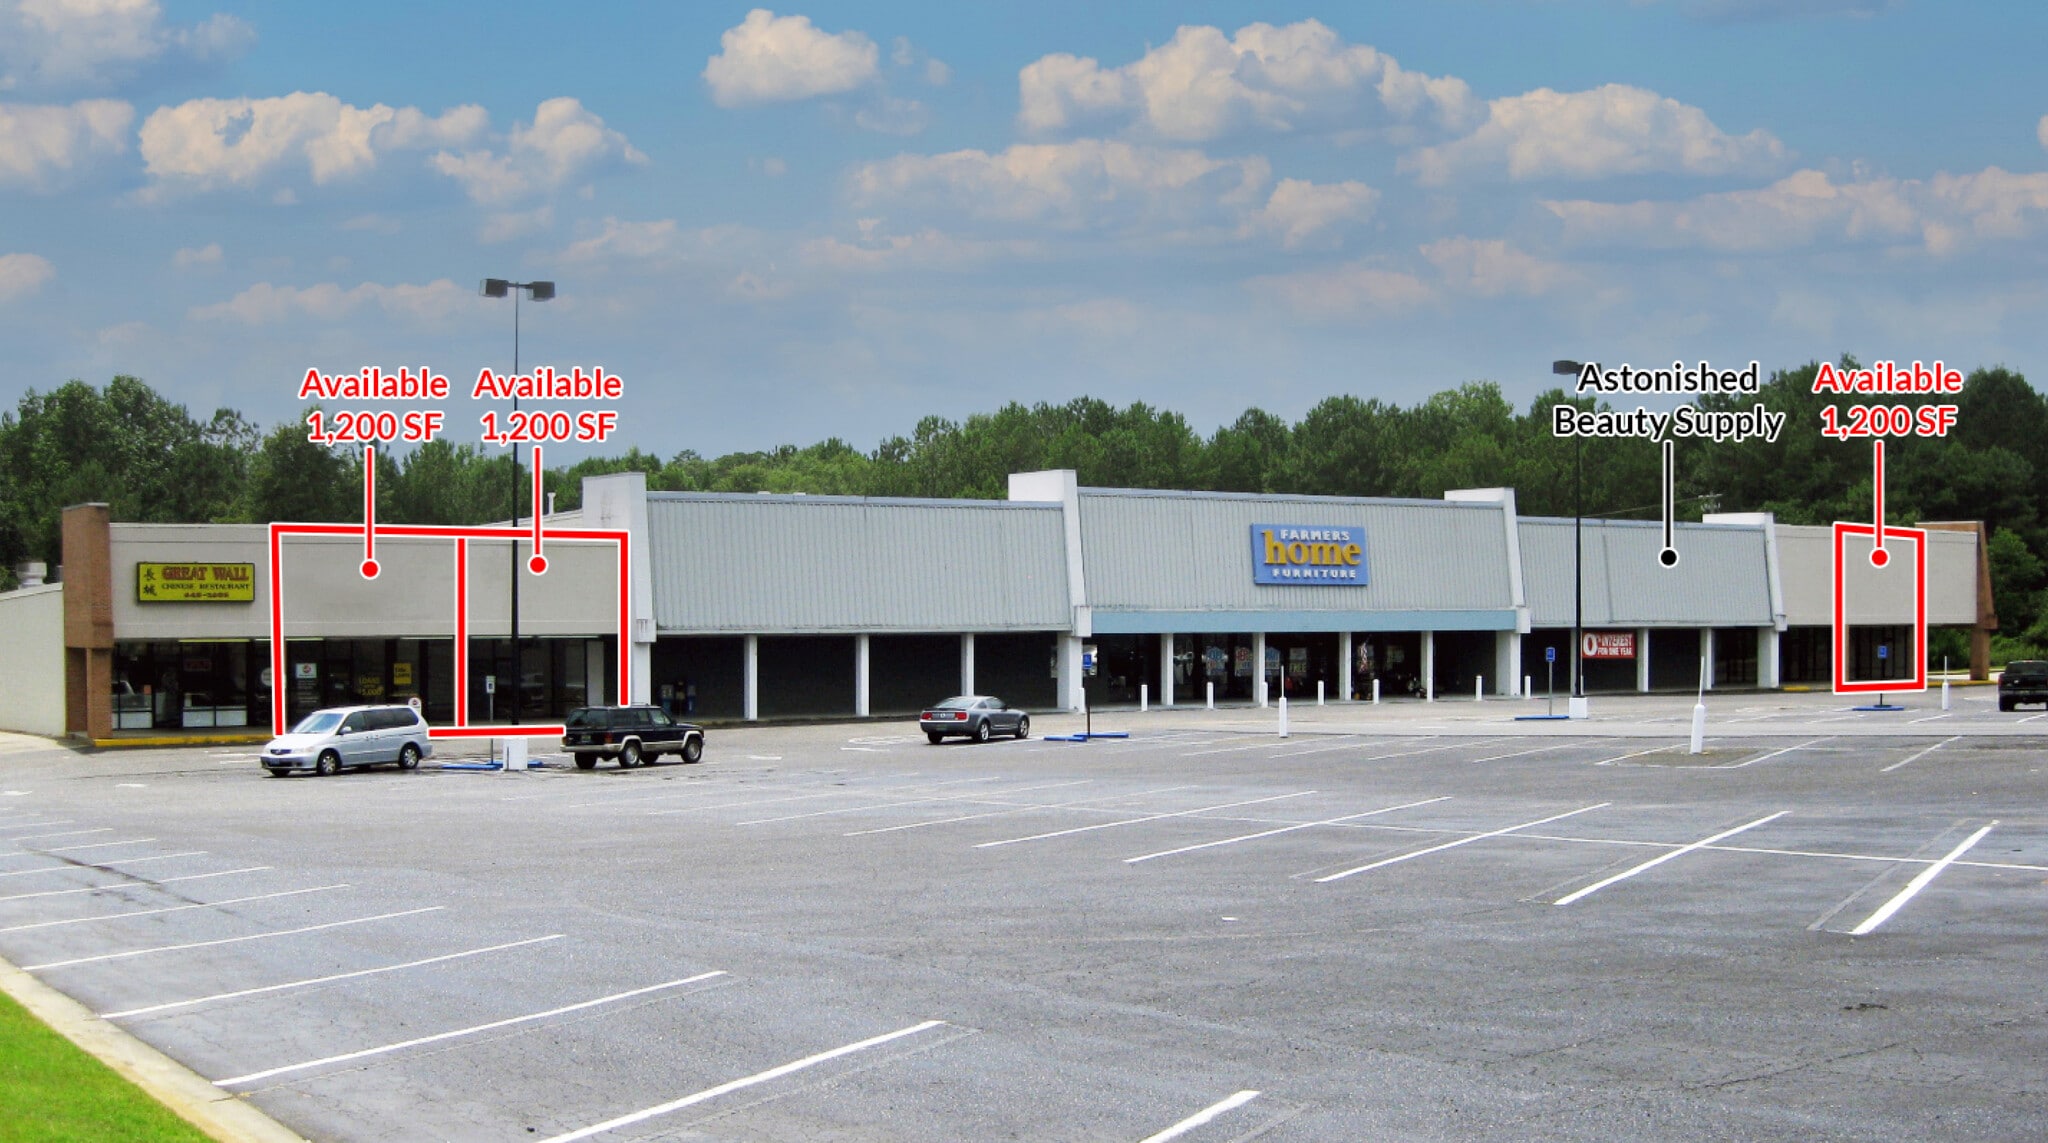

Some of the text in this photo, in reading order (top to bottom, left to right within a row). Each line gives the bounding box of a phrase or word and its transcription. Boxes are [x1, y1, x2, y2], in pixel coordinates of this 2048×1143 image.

[1280, 529, 1350, 541] FARMERS
[1262, 530, 1362, 566] home
[162, 566, 249, 582] GREAT WALL
[1272, 568, 1356, 578] FURNITURE
